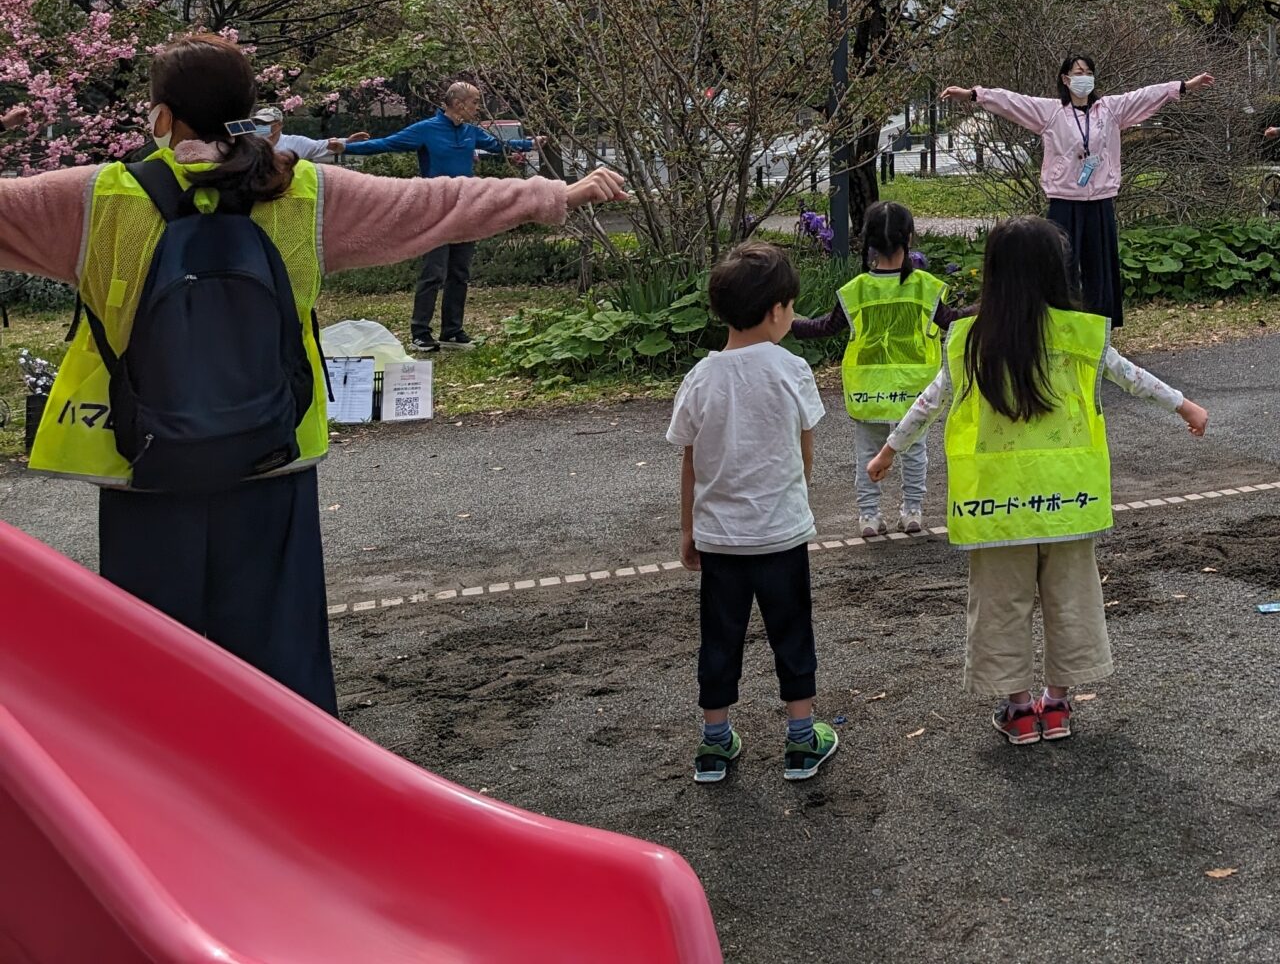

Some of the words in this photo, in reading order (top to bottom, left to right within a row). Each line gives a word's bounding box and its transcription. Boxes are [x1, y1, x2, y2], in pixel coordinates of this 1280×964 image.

[57, 399, 113, 430] ハマ
[952, 491, 1099, 518] ハマロード・サポーター
